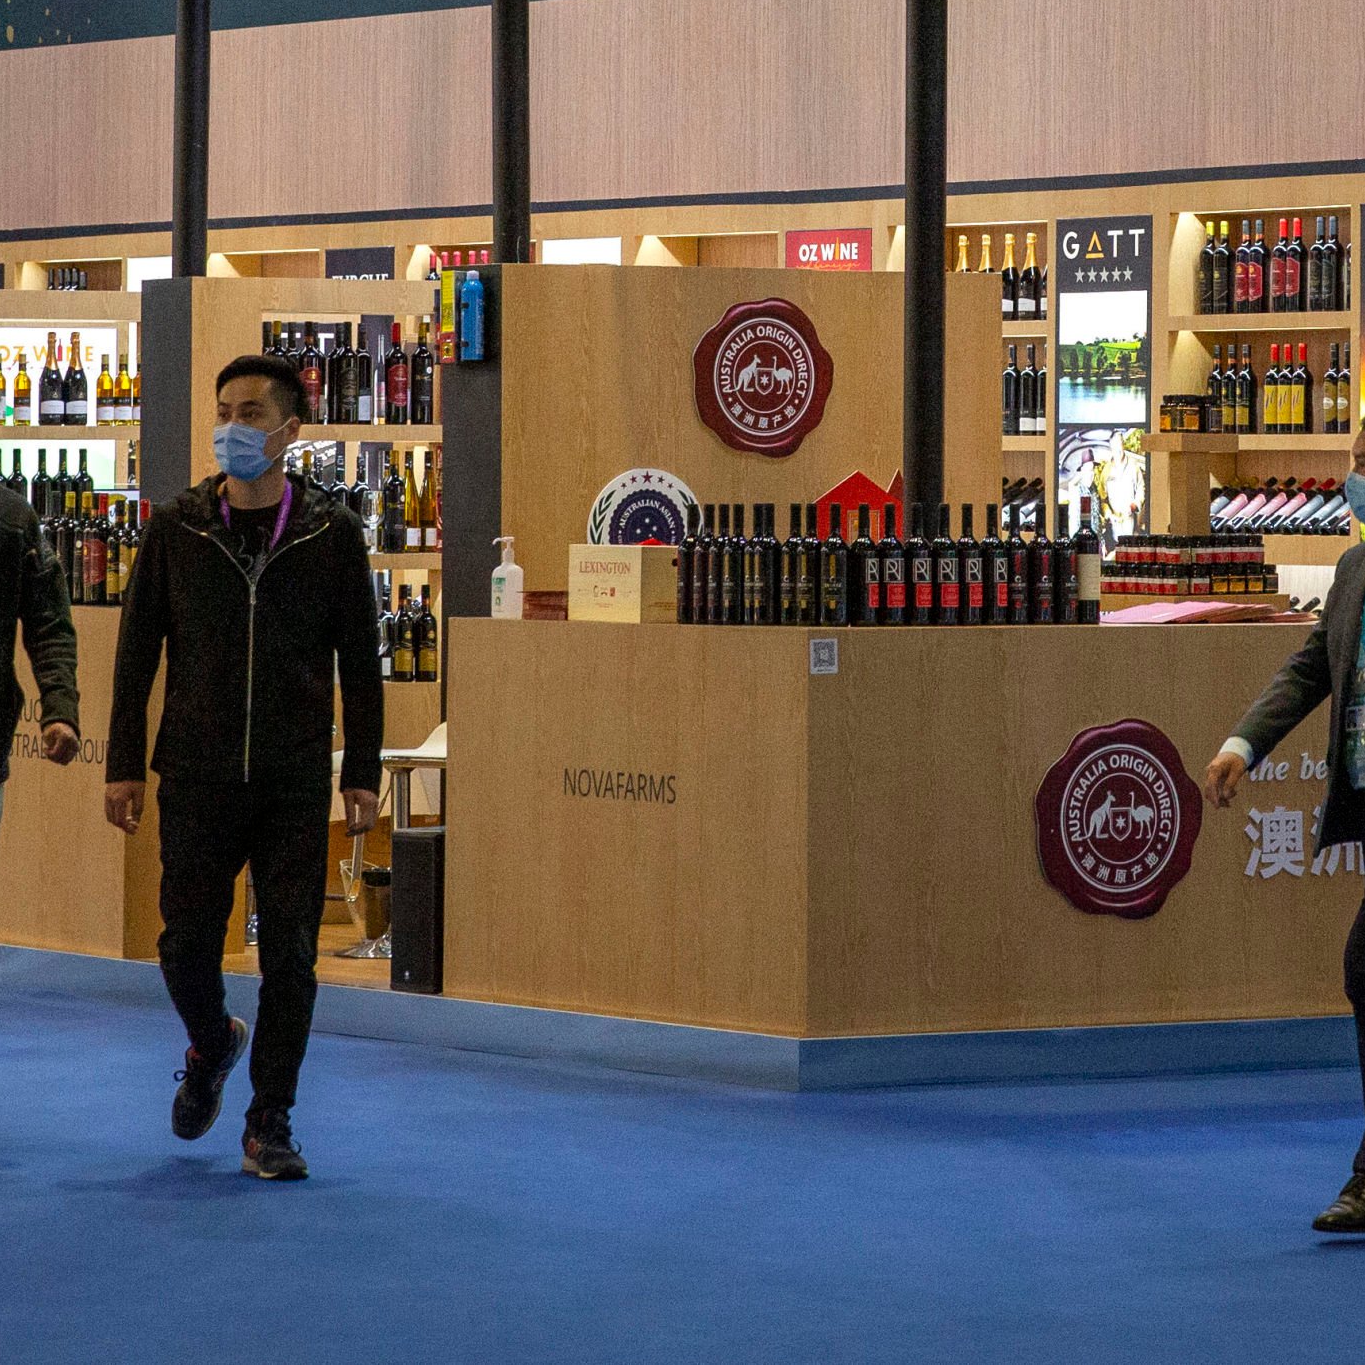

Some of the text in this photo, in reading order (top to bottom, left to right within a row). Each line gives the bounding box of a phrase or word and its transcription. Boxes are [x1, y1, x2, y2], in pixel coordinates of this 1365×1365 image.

[798, 243, 818, 262] OZ
[1062, 229, 1146, 261] GATT
[720, 325, 808, 399] AUSTRALIA ORIGIN DIRECT
[619, 498, 676, 530] AUSTRALIAN ASIAN
[578, 561, 631, 575] LEXINGTON
[1249, 756, 1290, 782] the
[562, 768, 677, 806] NOVAFARMS
[1068, 754, 1172, 842] AUSTRALIA ORIGIN DIRECT
